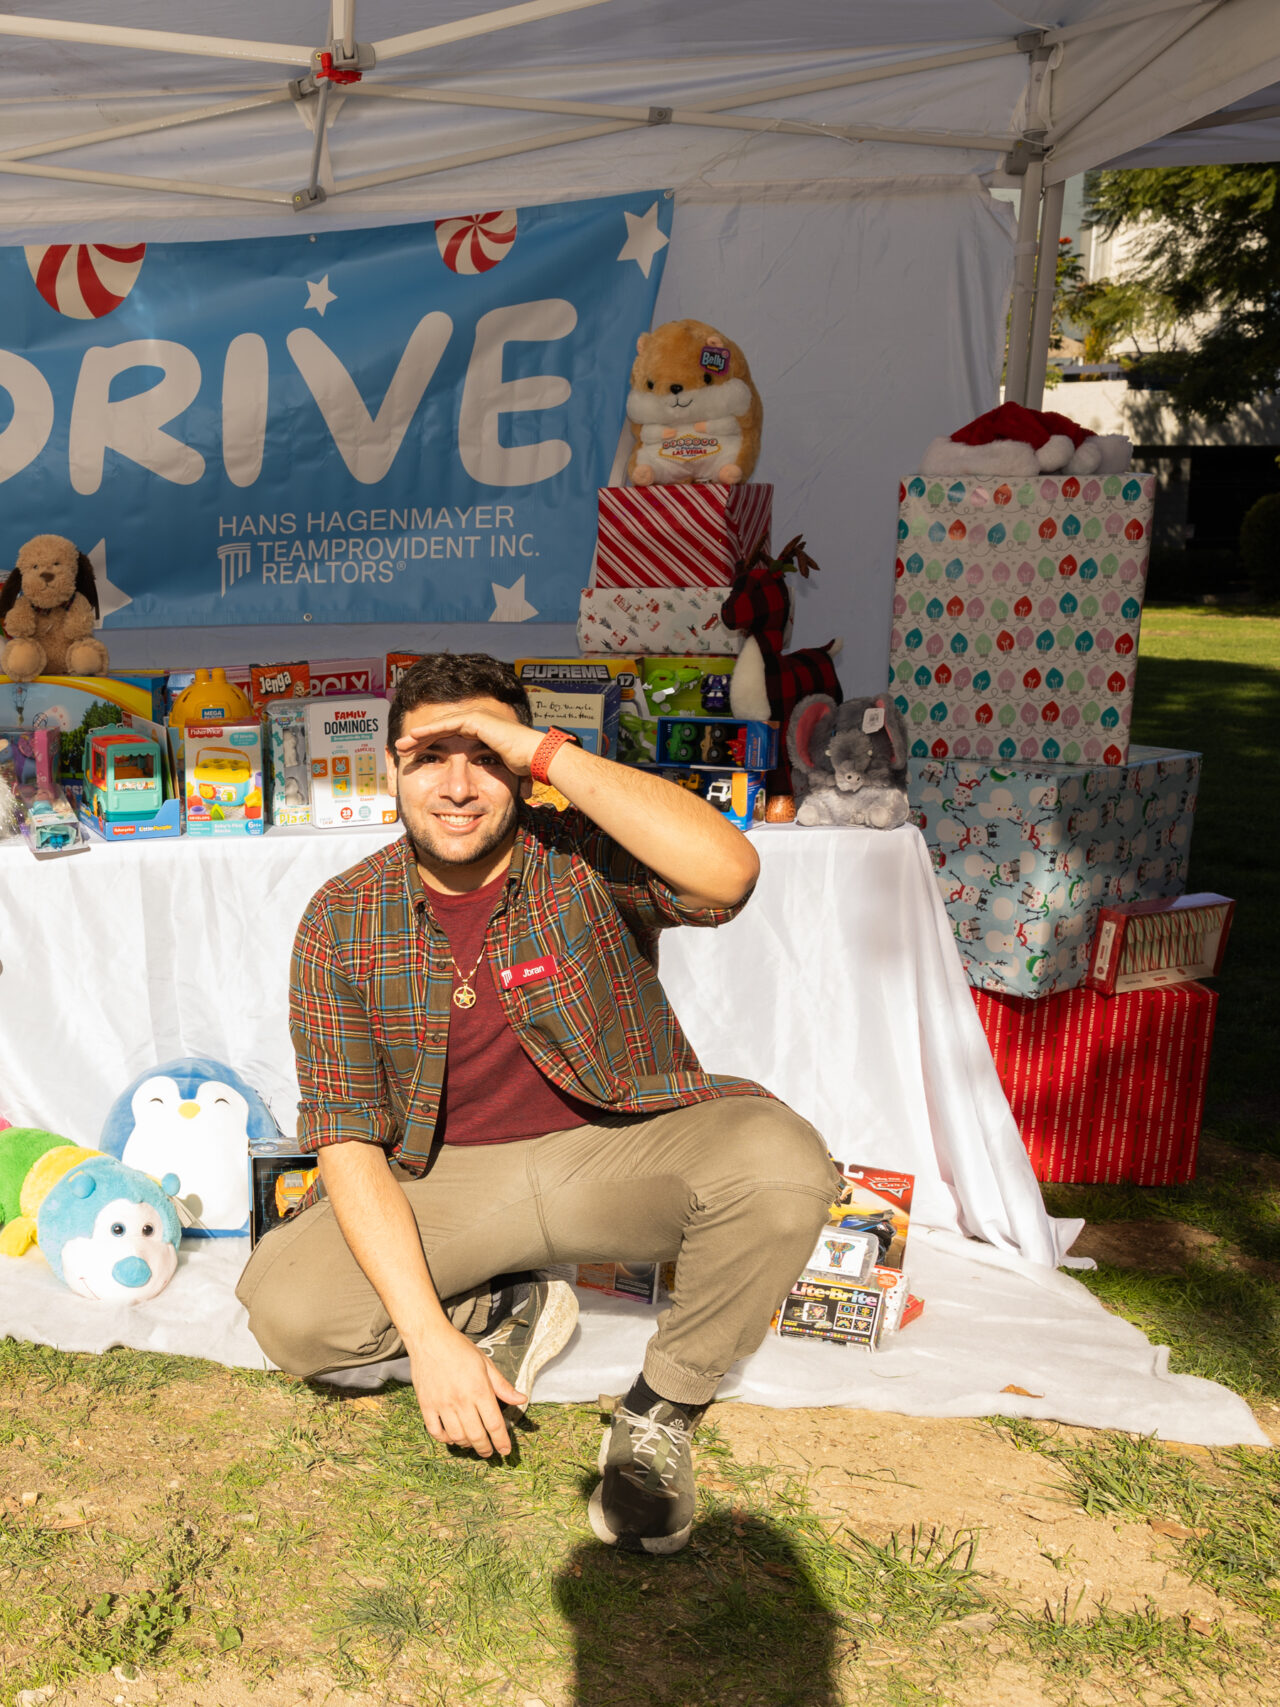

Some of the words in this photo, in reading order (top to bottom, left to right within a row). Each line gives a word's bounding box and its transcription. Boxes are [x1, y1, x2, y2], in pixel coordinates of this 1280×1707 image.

[219, 512, 297, 537] HANS
[307, 505, 515, 535] HAGENMAYER
[257, 536, 482, 563] TEAMPROVIDENT
[490, 533, 540, 559] INC.
[522, 665, 609, 679] SUPREME
[619, 675, 633, 686] 17
[259, 671, 292, 694] Jenga
[334, 710, 367, 720] FAMILY
[324, 718, 378, 735] DOMINOES
